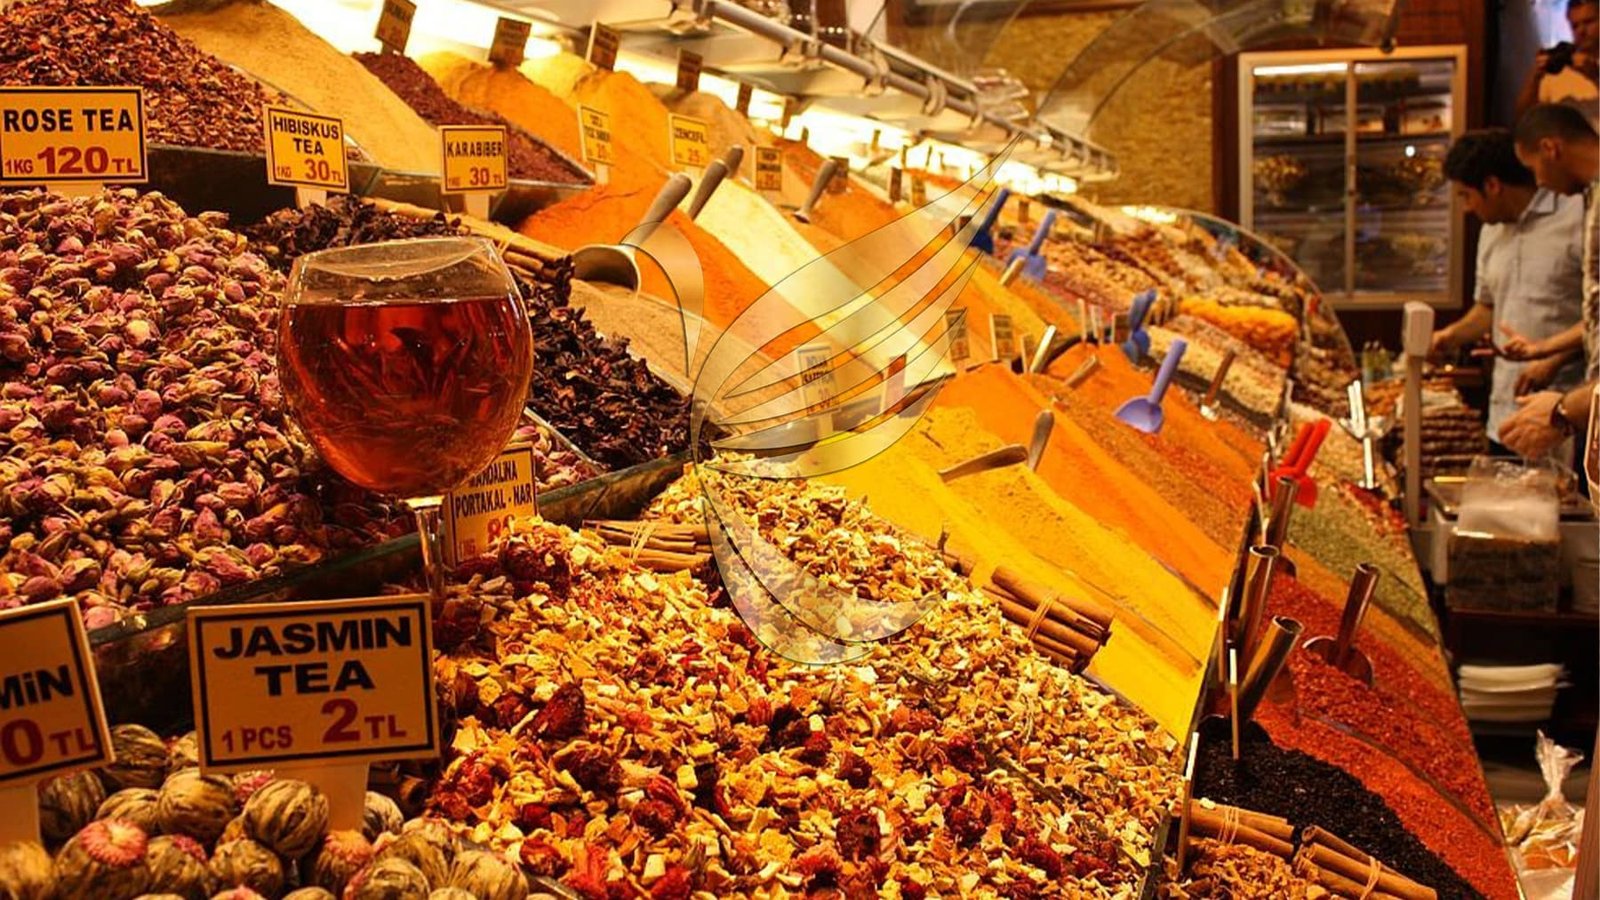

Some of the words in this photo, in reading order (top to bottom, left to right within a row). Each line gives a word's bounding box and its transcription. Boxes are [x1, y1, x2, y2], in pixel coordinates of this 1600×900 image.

[3, 108, 73, 132] ROSE
[82, 108, 134, 131] TEA
[273, 116, 339, 140] HIBISKUS
[293, 137, 324, 155] TEA
[447, 142, 503, 157] KARABIBER
[5, 158, 33, 174] 1KG
[37, 146, 108, 174] 120
[111, 158, 138, 173] TL
[304, 158, 329, 180] 30
[331, 170, 343, 183] TL
[470, 167, 489, 186] 30
[456, 489, 506, 518] PORTAKAL
[513, 483, 533, 506] NAR
[214, 617, 411, 659] JASMIN
[255, 660, 375, 696] TEA
[222, 730, 233, 753] 1
[241, 725, 293, 751] PCS
[321, 698, 361, 743] 2
[365, 715, 407, 739] TL
[49, 728, 96, 755] TL
